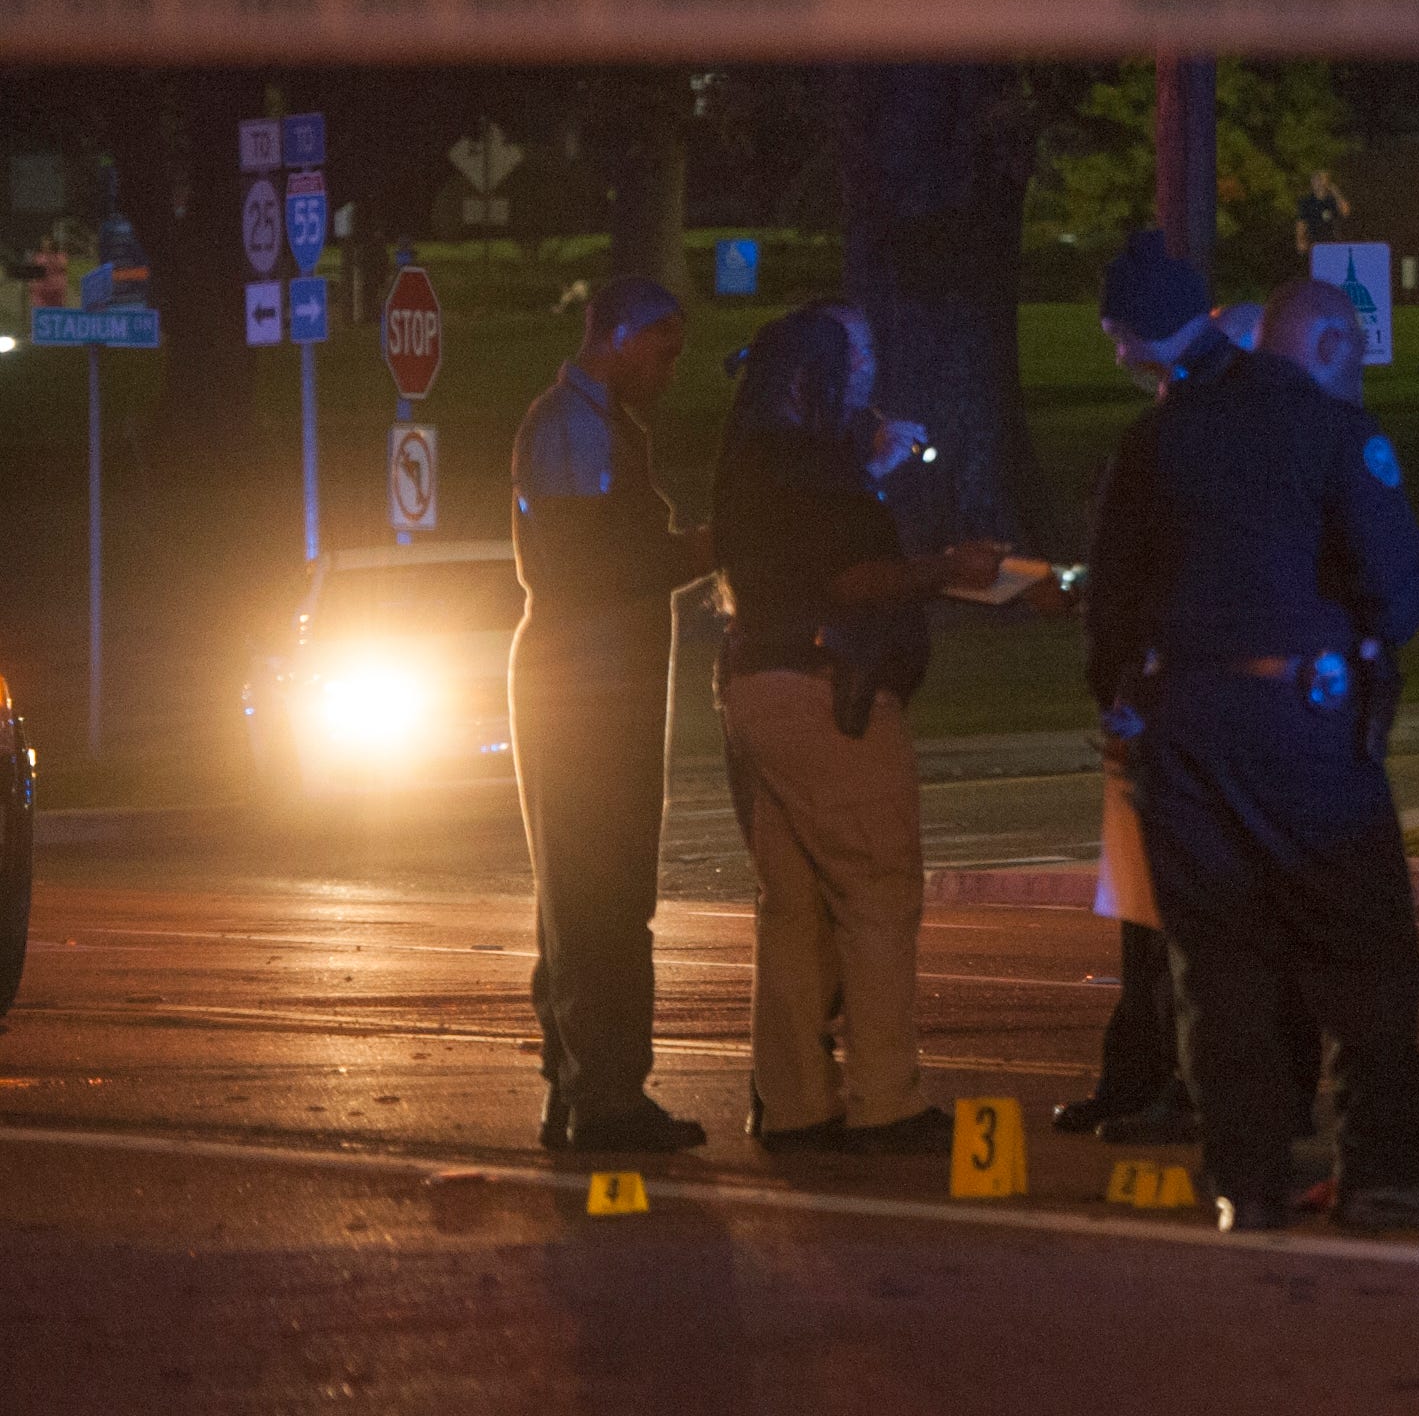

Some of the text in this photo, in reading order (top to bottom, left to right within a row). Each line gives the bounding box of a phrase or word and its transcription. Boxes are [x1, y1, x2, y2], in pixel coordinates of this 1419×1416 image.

[250, 200, 275, 253] 25
[294, 199, 320, 245] 55
[37, 314, 127, 339] STADIUM
[390, 309, 437, 356] STOP
[971, 1106, 997, 1171] 3
